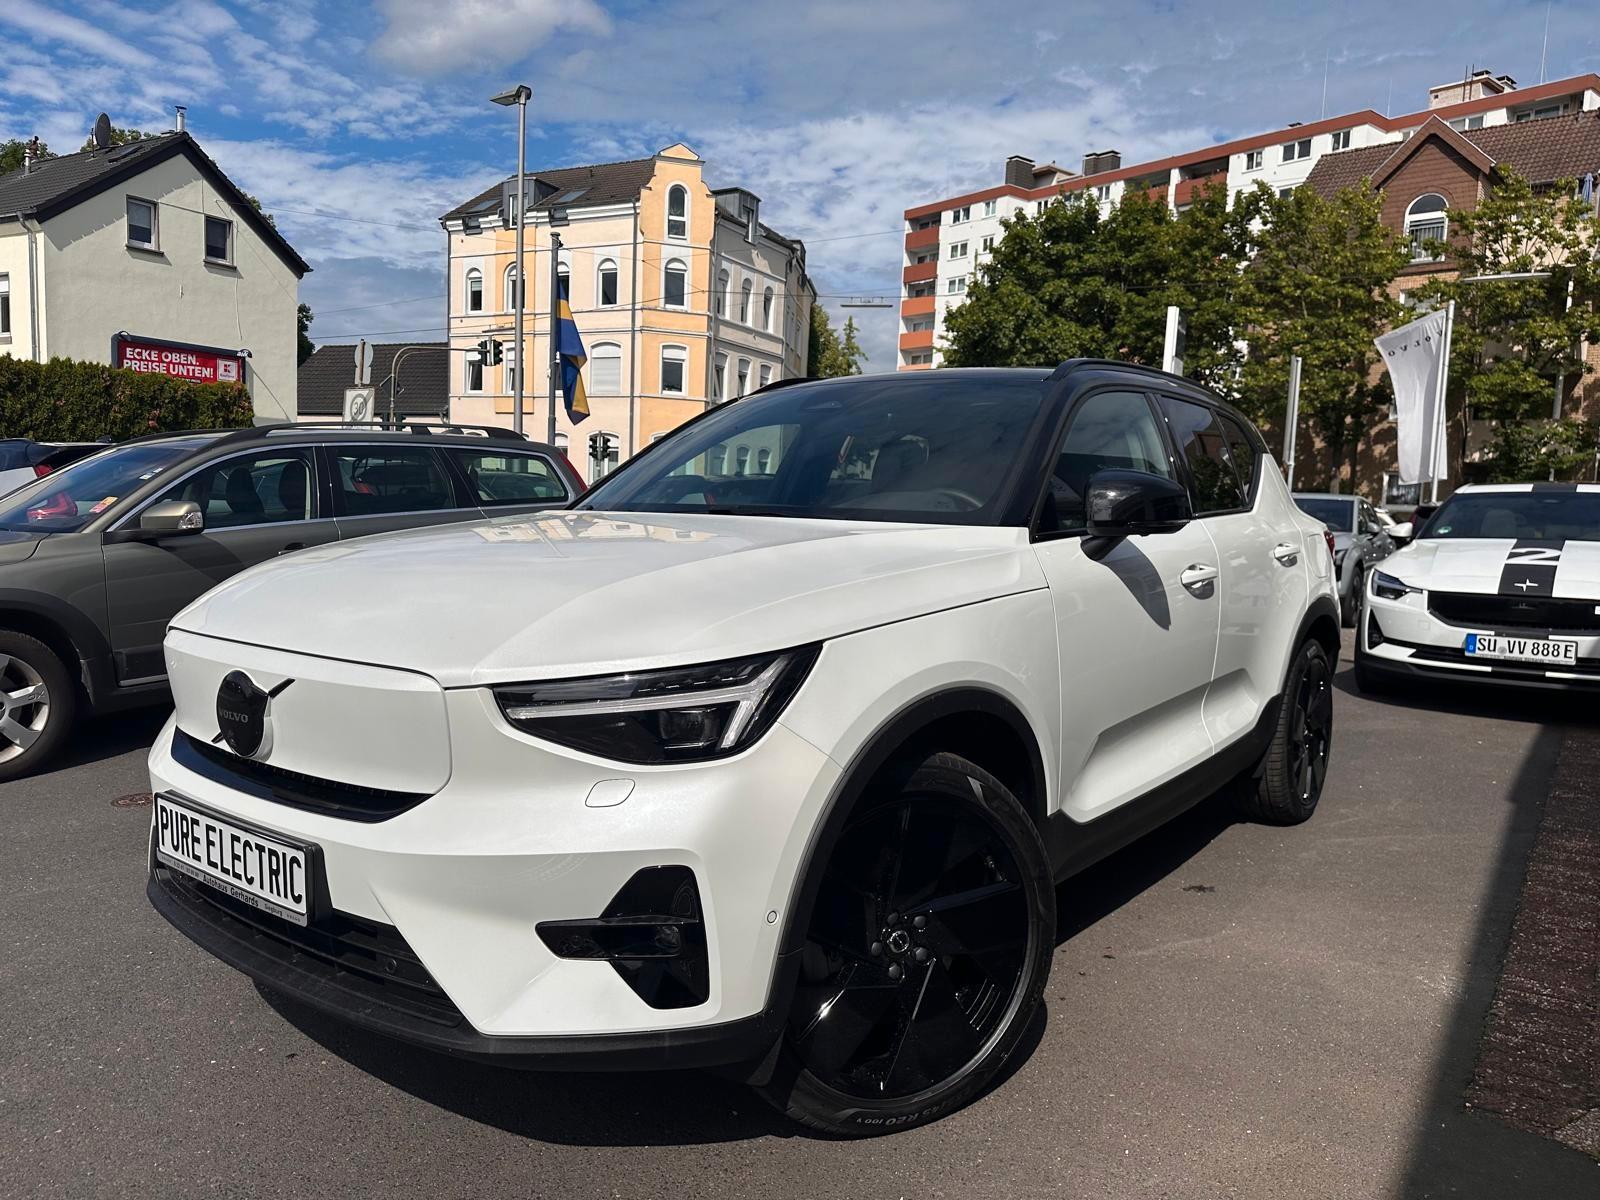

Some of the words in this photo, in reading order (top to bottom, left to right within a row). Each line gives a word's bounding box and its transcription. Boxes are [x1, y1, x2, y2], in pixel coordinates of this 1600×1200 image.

[126, 347, 158, 361] ECKE
[162, 351, 200, 366] OBEN.
[123, 359, 167, 374] PREISE
[169, 364, 214, 378] UNTEN!
[353, 401, 365, 416] 30
[1478, 637, 1497, 652] SU
[1507, 640, 1527, 654] VV
[159, 804, 201, 863] PURE
[205, 823, 302, 905] ELECTRIC
[202, 872, 228, 893] Autohaus
[230, 887, 259, 907] Gerhards
